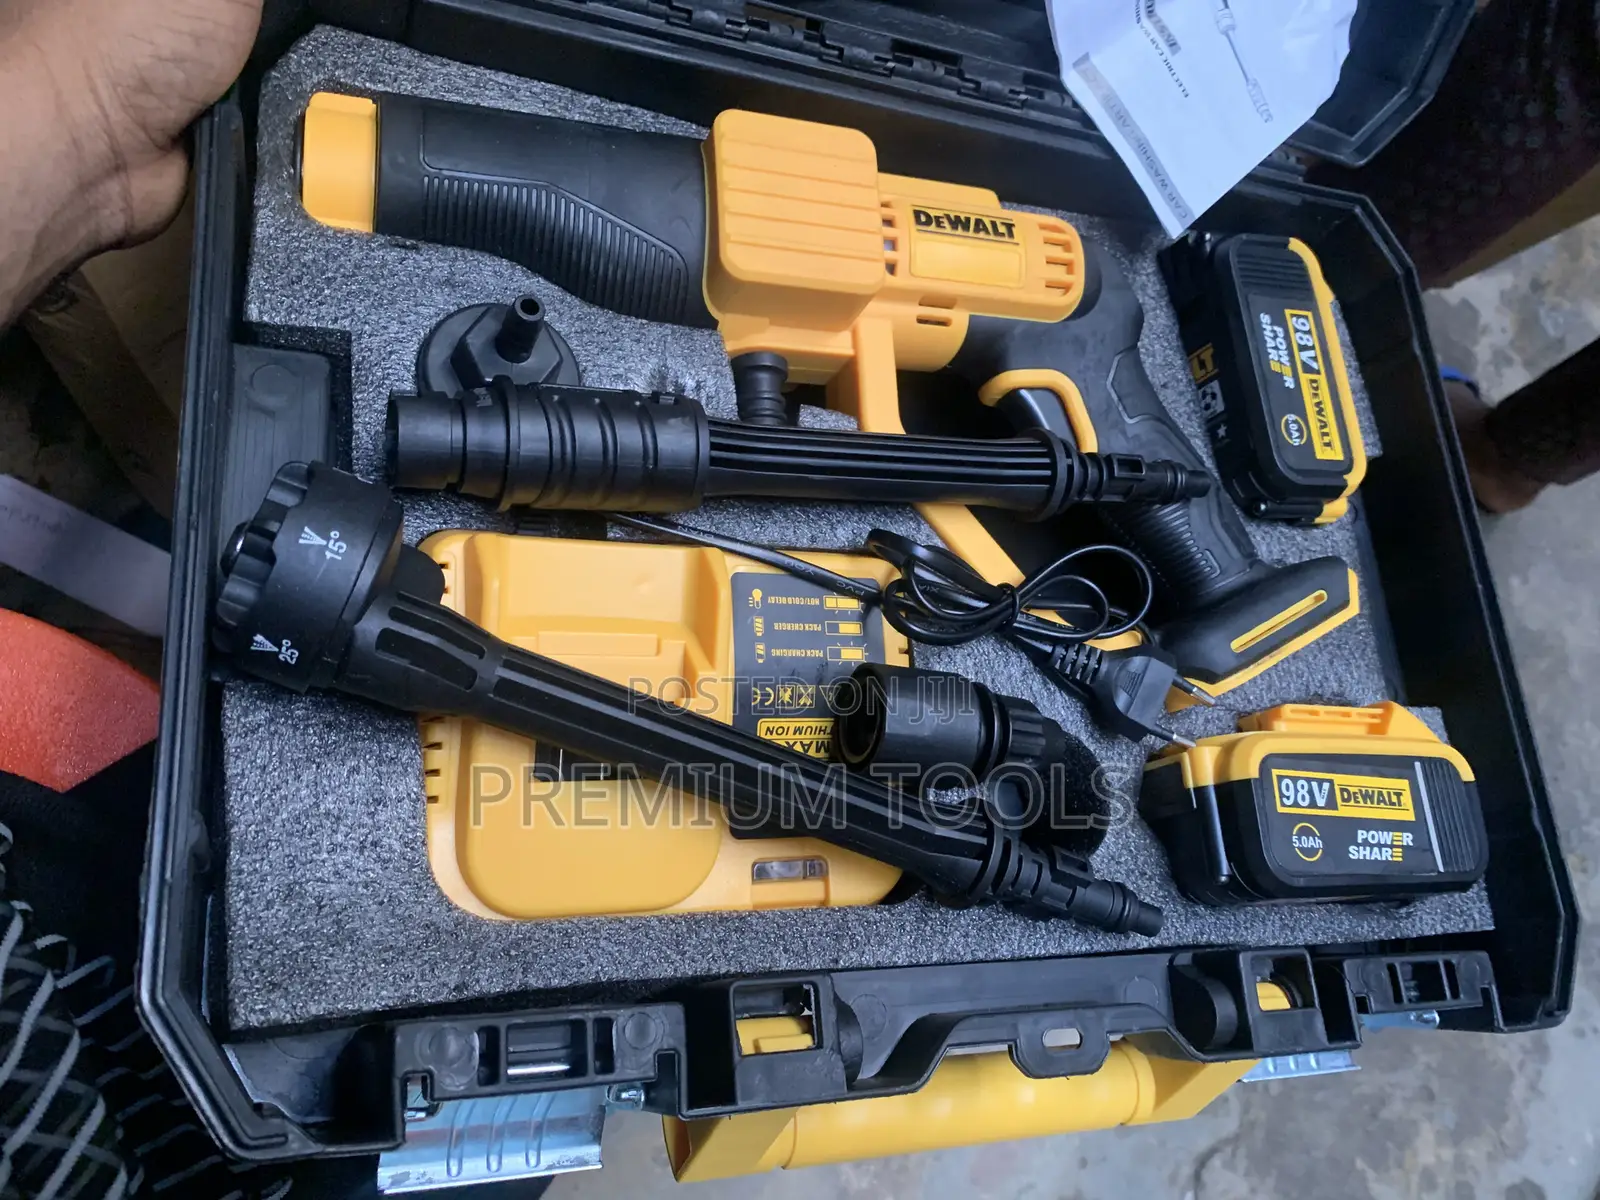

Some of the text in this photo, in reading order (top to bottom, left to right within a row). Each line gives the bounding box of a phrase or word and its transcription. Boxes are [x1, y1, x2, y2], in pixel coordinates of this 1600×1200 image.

[1167, 192, 1189, 219] CAR
[913, 208, 1016, 240] DEWALT
[1259, 313, 1282, 373] SHARE
[1272, 325, 1296, 389] POWER
[1291, 316, 1334, 452] 98V DEWALT
[765, 725, 790, 736] ION
[1280, 778, 1330, 807] 98V
[1339, 786, 1404, 808] DEWALT
[1292, 834, 1323, 849] 5.0Ah
[1357, 829, 1414, 847] POWER
[1348, 846, 1403, 862] SHARE
